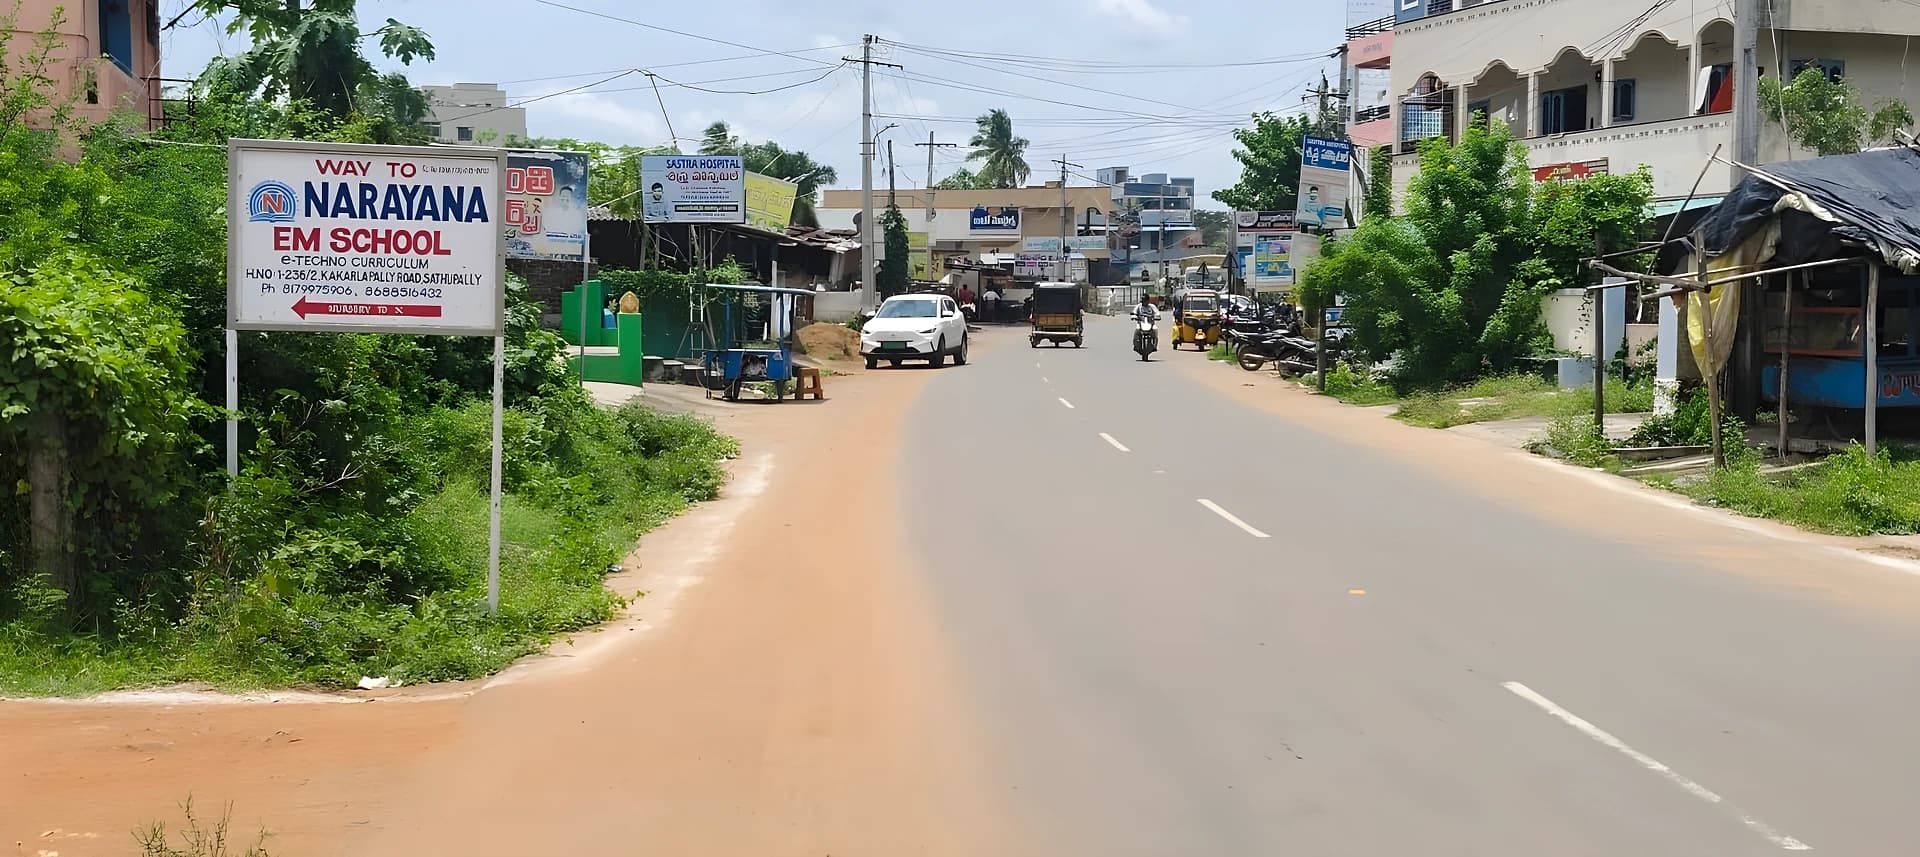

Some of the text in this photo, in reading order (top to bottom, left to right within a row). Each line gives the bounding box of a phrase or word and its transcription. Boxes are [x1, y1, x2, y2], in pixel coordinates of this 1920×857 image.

[315, 159, 372, 176] WAY
[386, 162, 417, 178] TO
[700, 160, 741, 169] HOSPITAL
[261, 194, 283, 214] N
[304, 181, 489, 223] NARAYANA
[273, 226, 452, 256] EM SCHOOL
[281, 255, 429, 270] e-TECHNO CURRICULUM
[261, 283, 276, 293] Ph
[365, 286, 442, 299] 8688516432
